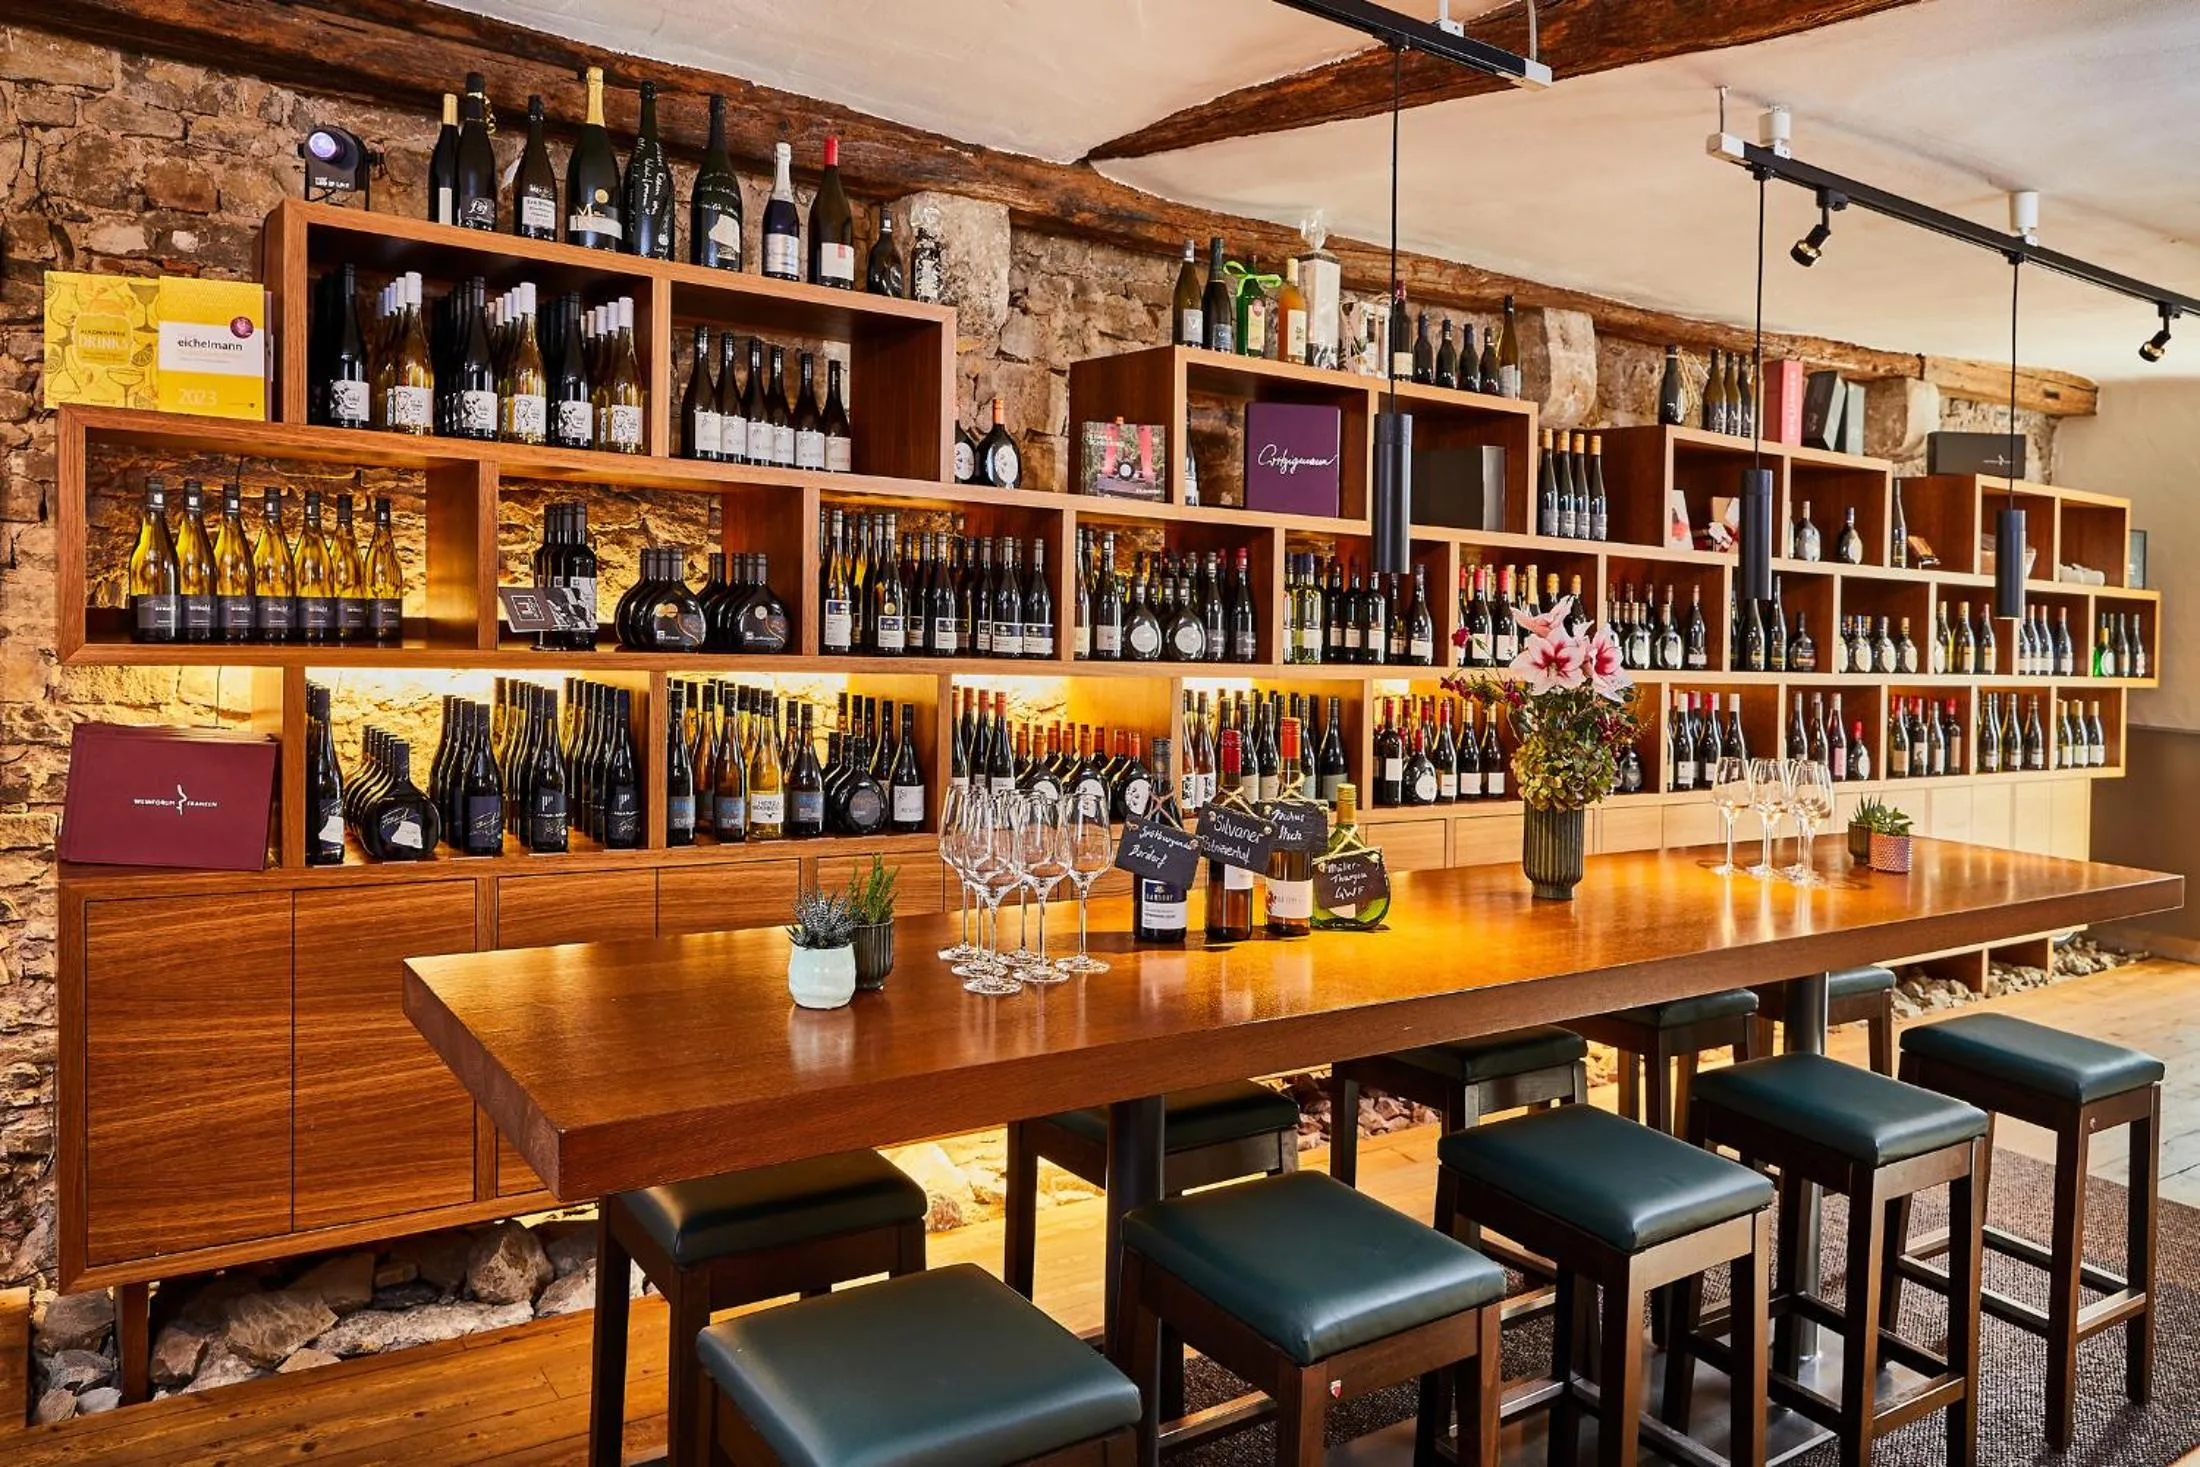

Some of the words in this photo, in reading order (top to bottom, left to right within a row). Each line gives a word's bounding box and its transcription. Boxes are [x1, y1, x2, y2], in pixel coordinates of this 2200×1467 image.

[177, 337, 244, 352] eichelmann
[177, 388, 218, 406] 2023
[1213, 814, 1265, 845] Silvaner
[1335, 885, 1365, 900] GWF
